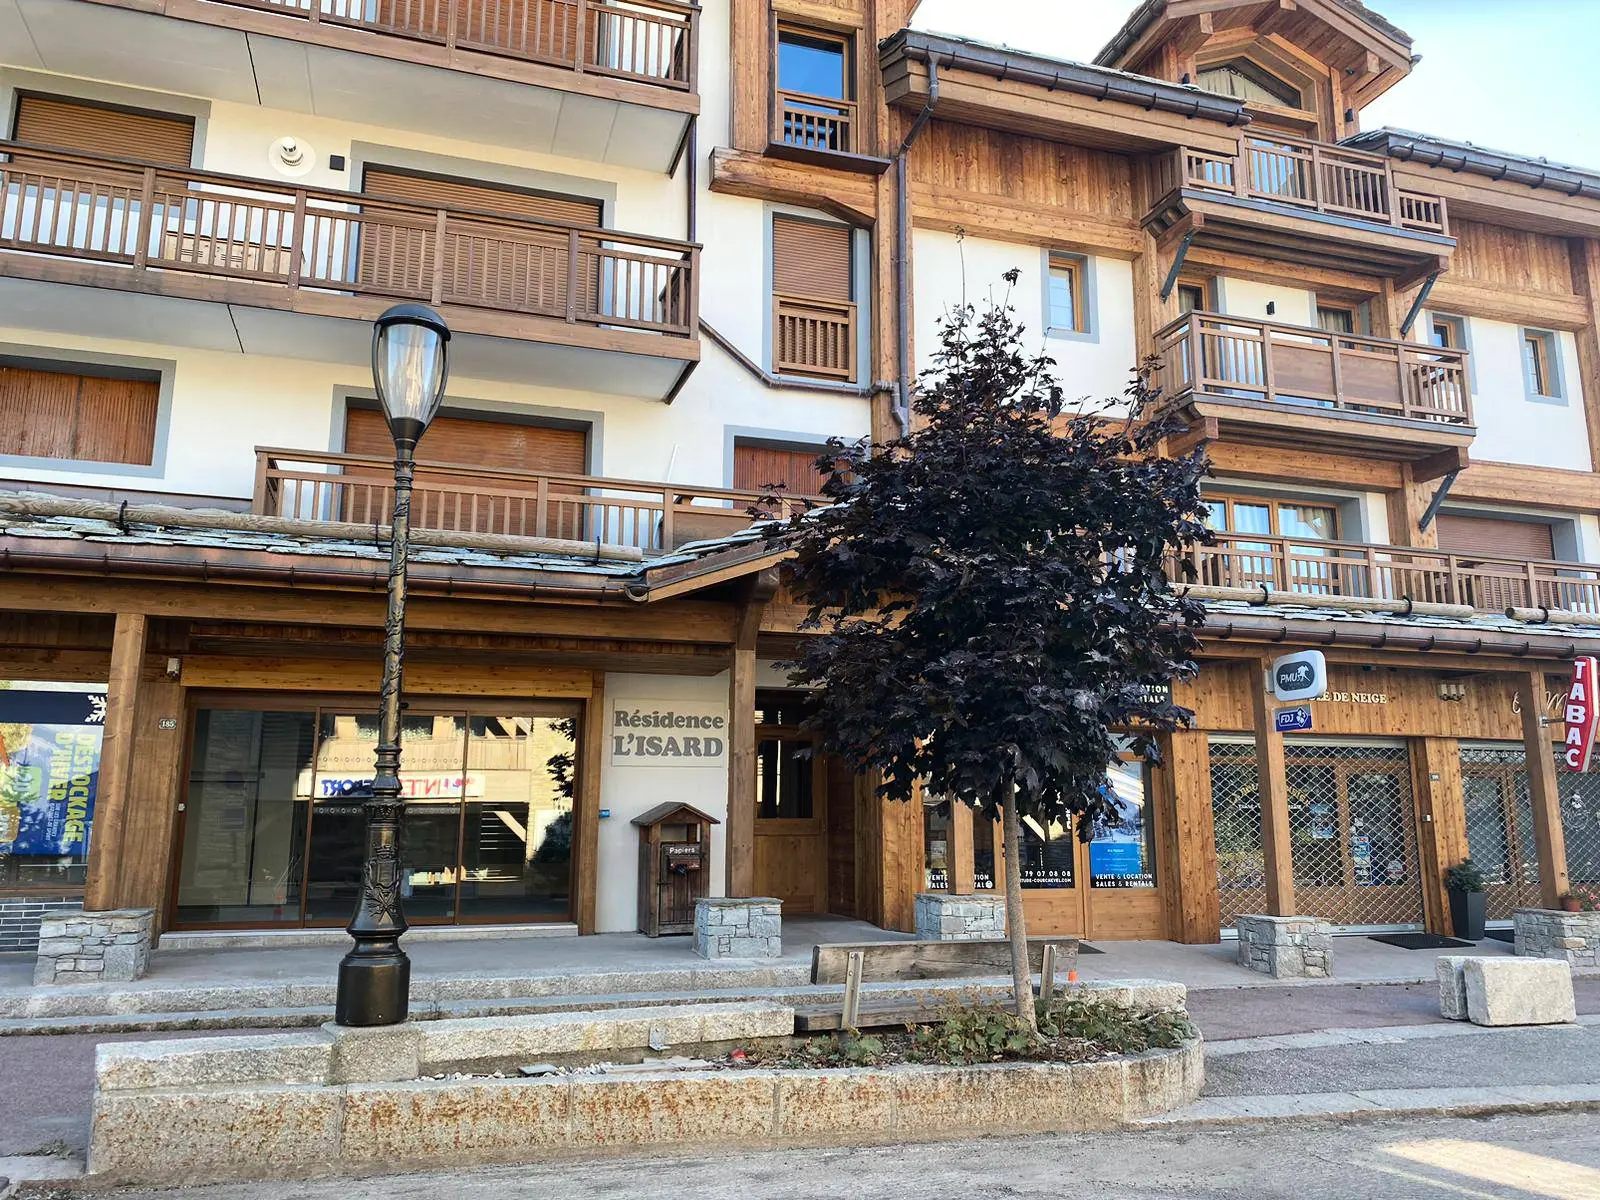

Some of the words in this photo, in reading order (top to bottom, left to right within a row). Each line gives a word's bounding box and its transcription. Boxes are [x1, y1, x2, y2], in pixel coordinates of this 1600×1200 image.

[1280, 673, 1298, 684] PMU
[1333, 691, 1350, 702] DE
[1351, 692, 1388, 704] NEIGE
[614, 709, 724, 729] Résidence
[1280, 714, 1294, 724] FDJ
[1566, 661, 1586, 767] TABAC
[613, 733, 724, 757] L'ISARD
